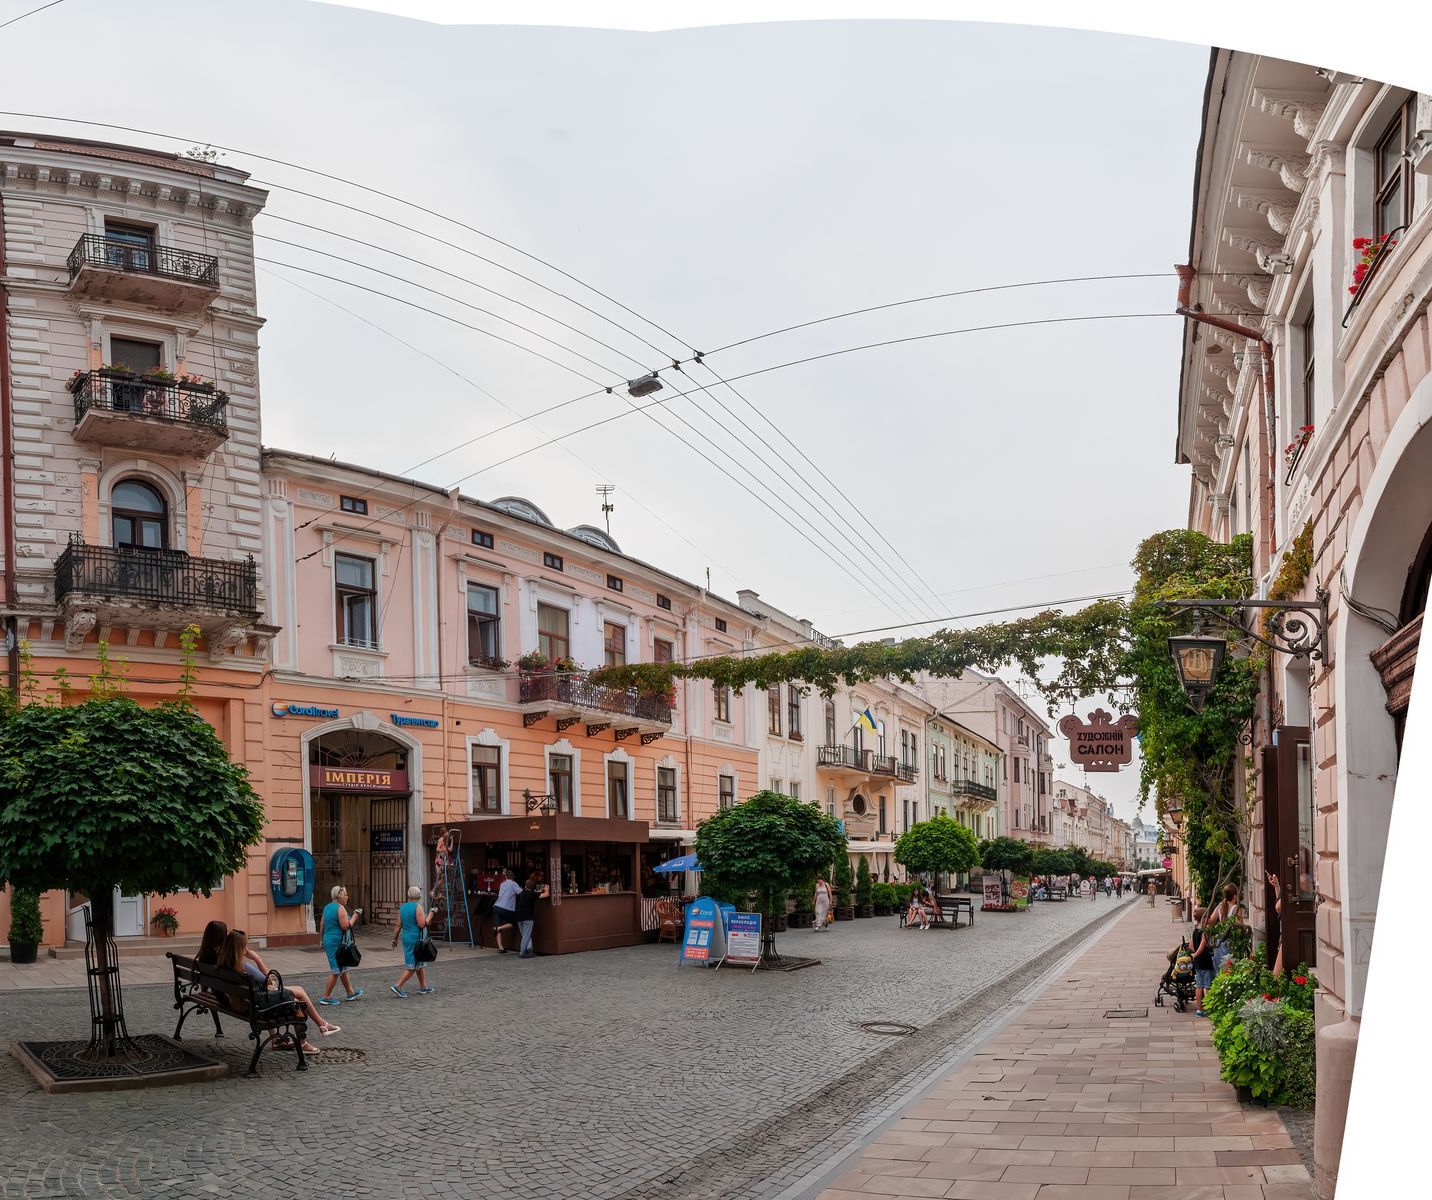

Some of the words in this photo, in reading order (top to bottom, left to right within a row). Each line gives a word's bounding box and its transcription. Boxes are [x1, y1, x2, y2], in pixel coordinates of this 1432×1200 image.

[1077, 730, 1123, 741] ХУДОЖНІЙ
[1077, 744, 1124, 755] САЛОН
[325, 771, 391, 785] ІМПЕРІЯ
